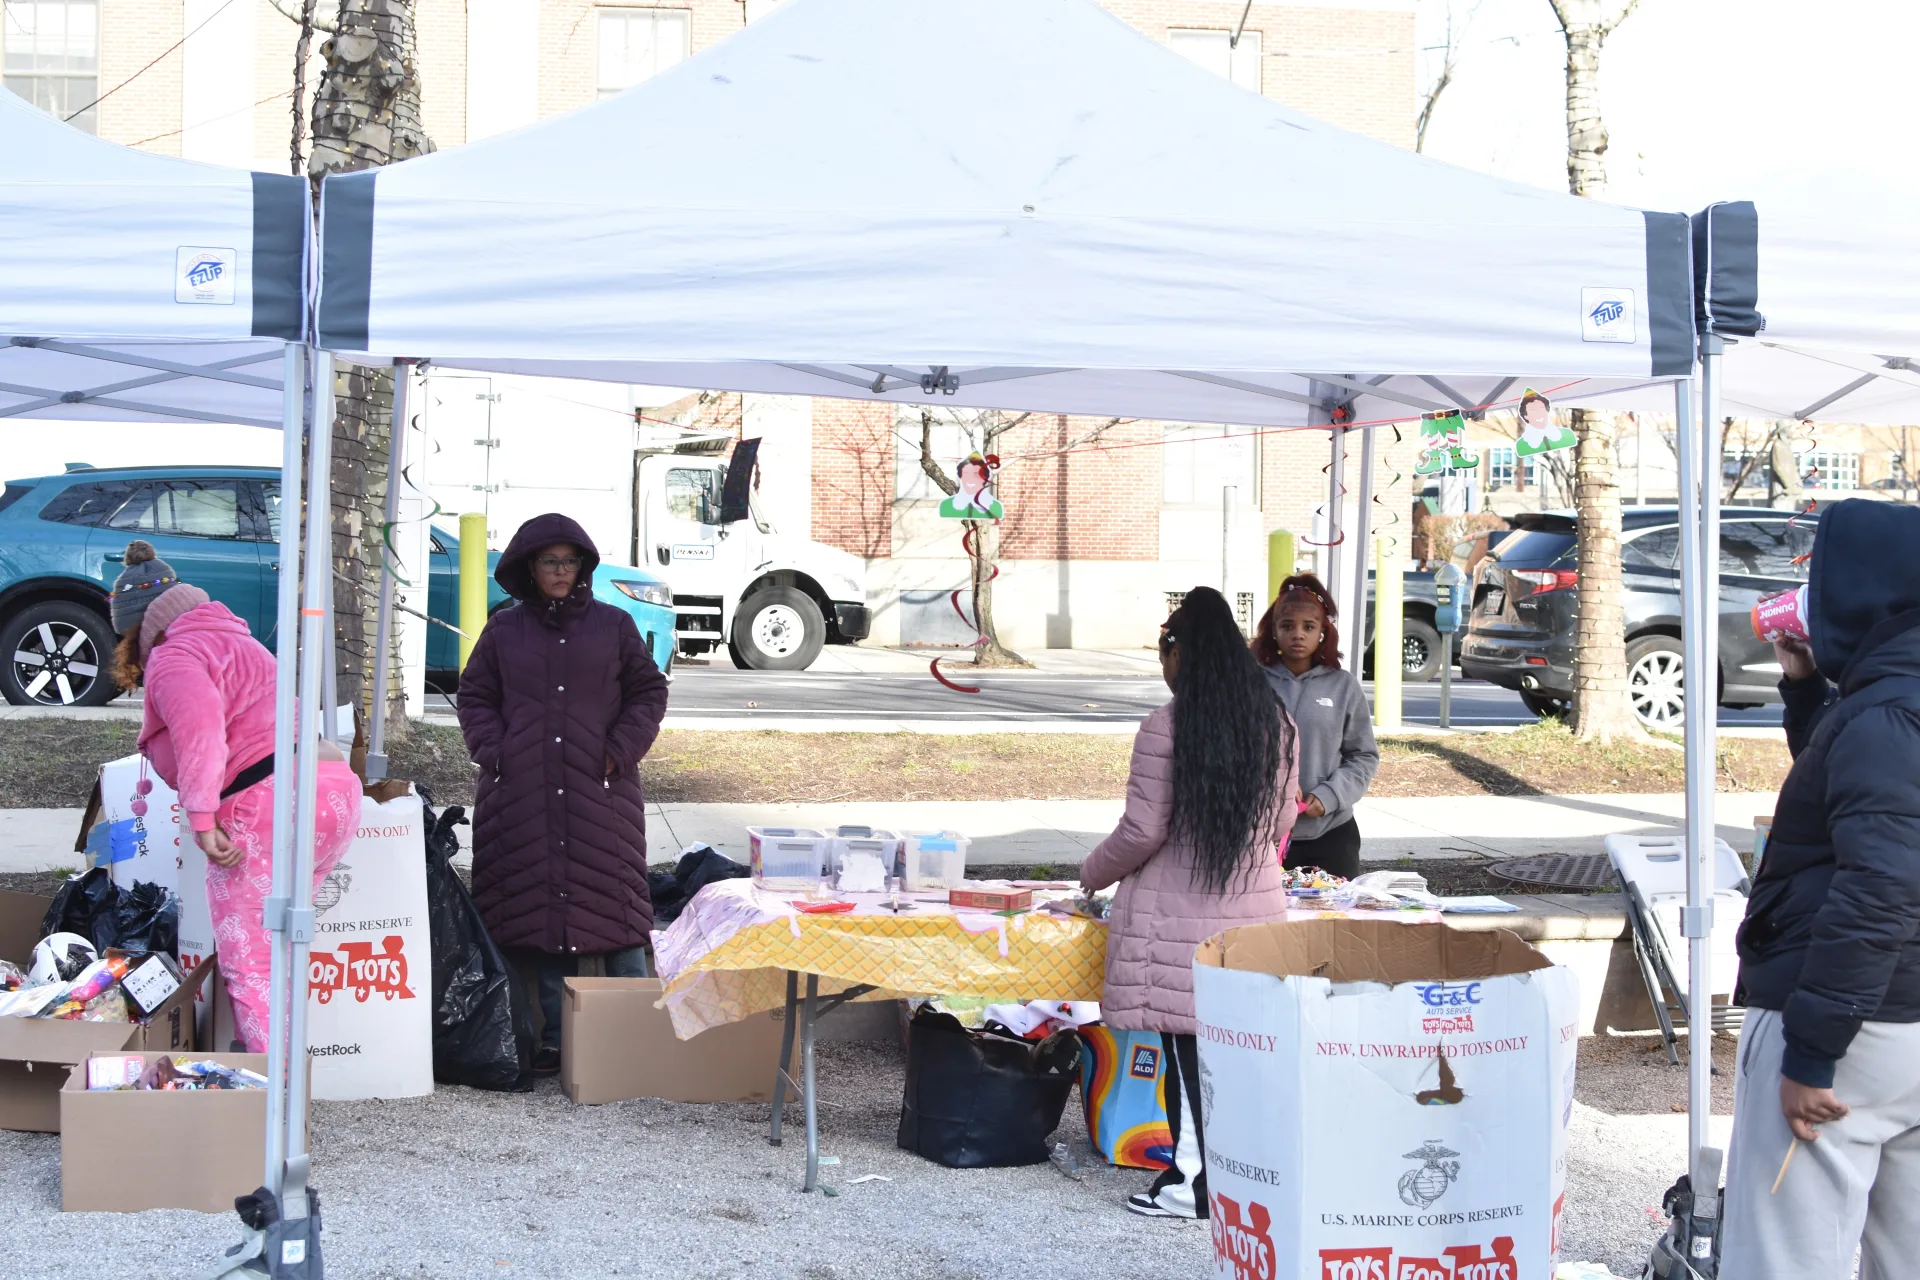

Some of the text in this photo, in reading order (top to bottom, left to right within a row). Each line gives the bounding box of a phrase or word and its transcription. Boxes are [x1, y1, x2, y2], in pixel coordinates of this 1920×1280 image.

[1519, 602, 1538, 610] RDX
[356, 825, 411, 839] OYS ONLY
[359, 917, 413, 931] RESERVE
[309, 957, 401, 986] OR TOTS
[1426, 1006, 1472, 1015] AUTO SERVICE
[1423, 1020, 1471, 1029] TOYS FOR TOTS
[1205, 1024, 1235, 1046] TOYS
[1237, 1031, 1277, 1052] ONLY
[1316, 1042, 1355, 1058] NEW,
[1460, 1041, 1492, 1056] TOYS
[1494, 1036, 1528, 1051] ONLY
[1134, 1064, 1153, 1073] ALDI
[1225, 1157, 1280, 1186] RESERVE
[1321, 1204, 1524, 1226] U.S. MARINE CORPS RESERVE
[1226, 1225, 1269, 1280] TOTS
[1325, 1255, 1385, 1280] TOYS
